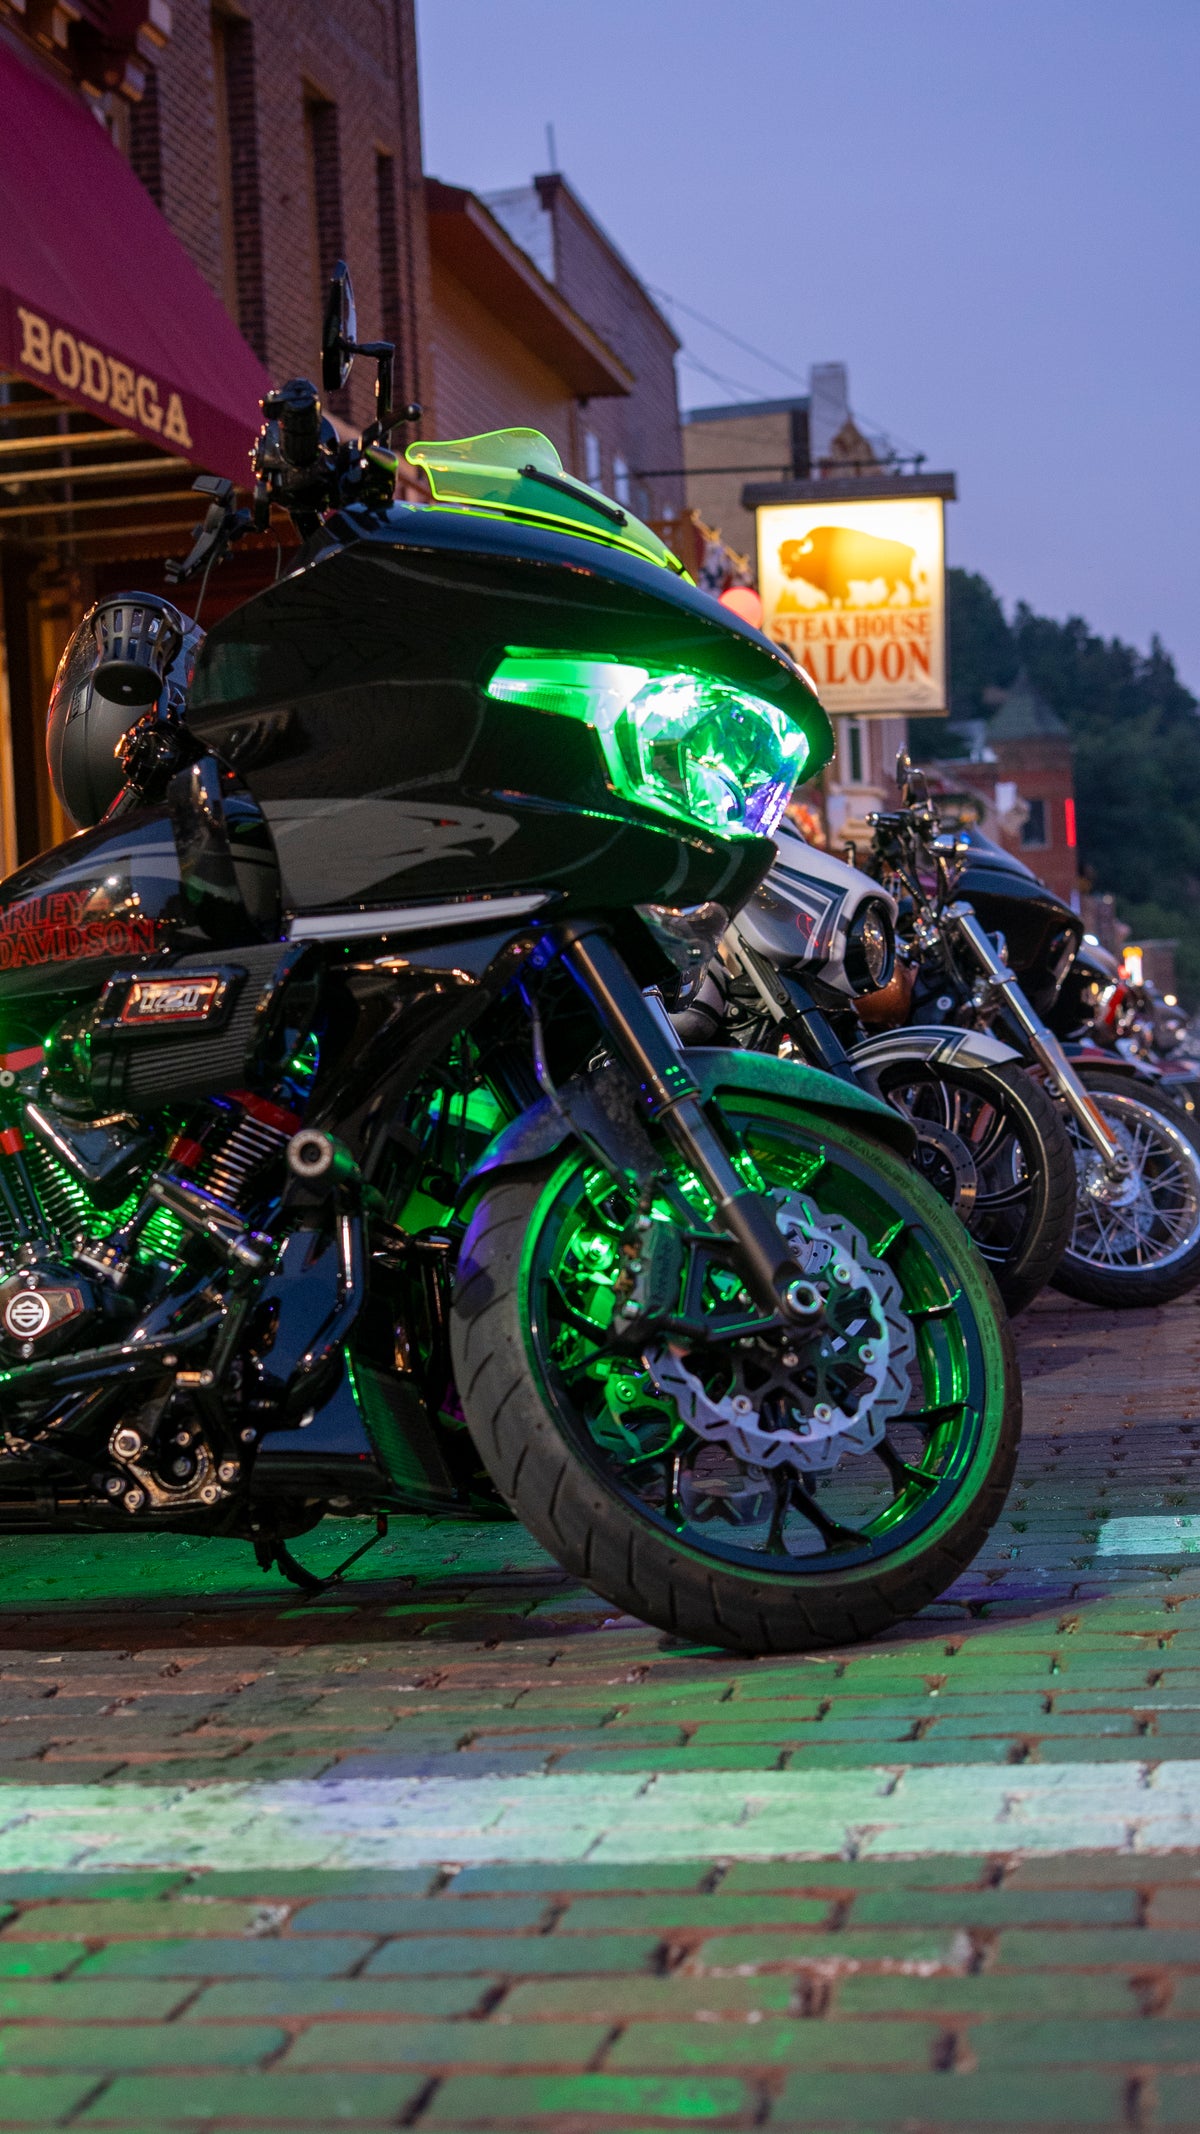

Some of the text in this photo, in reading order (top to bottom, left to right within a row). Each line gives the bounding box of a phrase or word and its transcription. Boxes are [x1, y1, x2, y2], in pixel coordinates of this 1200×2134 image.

[18, 306, 193, 449] BODEGA
[771, 614, 929, 641] STEAKHOUSE
[791, 641, 931, 684] ALOON
